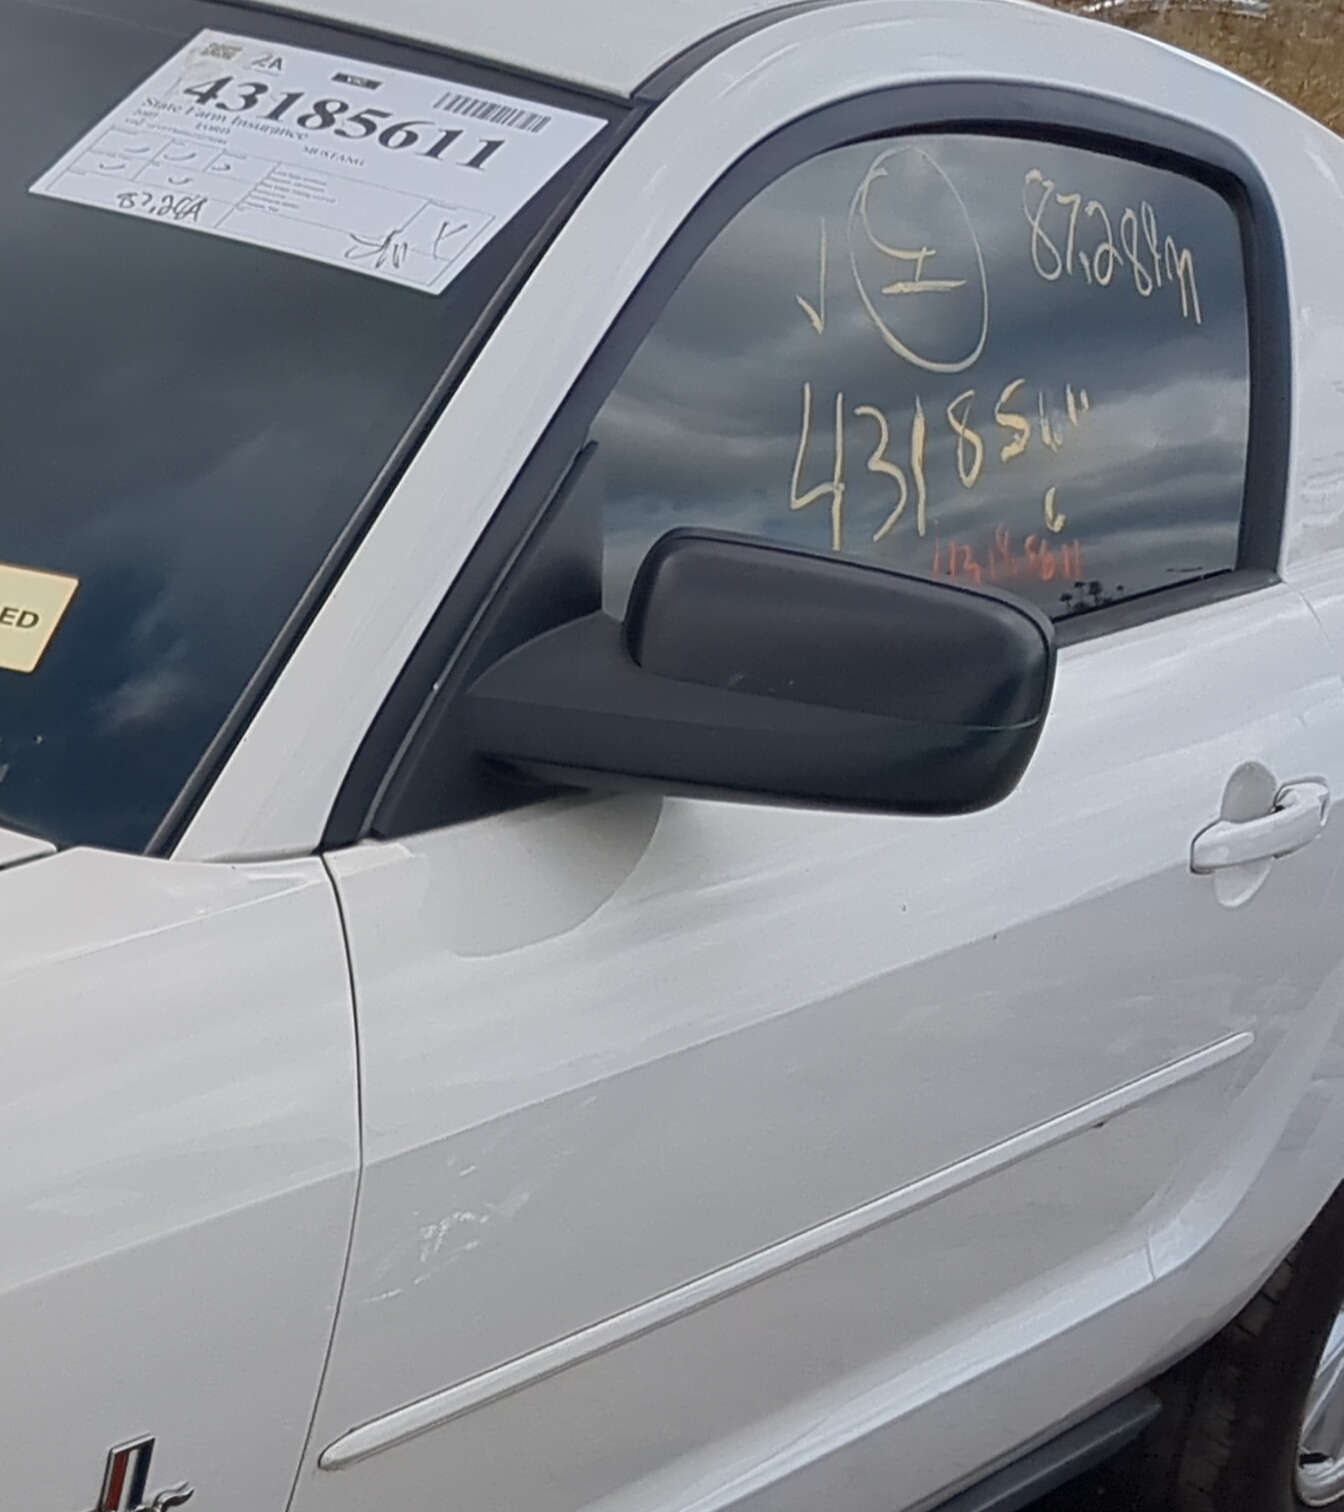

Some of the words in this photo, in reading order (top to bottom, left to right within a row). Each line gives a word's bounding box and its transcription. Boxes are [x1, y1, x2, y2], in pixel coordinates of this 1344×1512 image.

[140, 97, 183, 113] State
[184, 104, 227, 124] Farm
[231, 112, 309, 142] Insurance
[182, 74, 506, 172] 43185611
